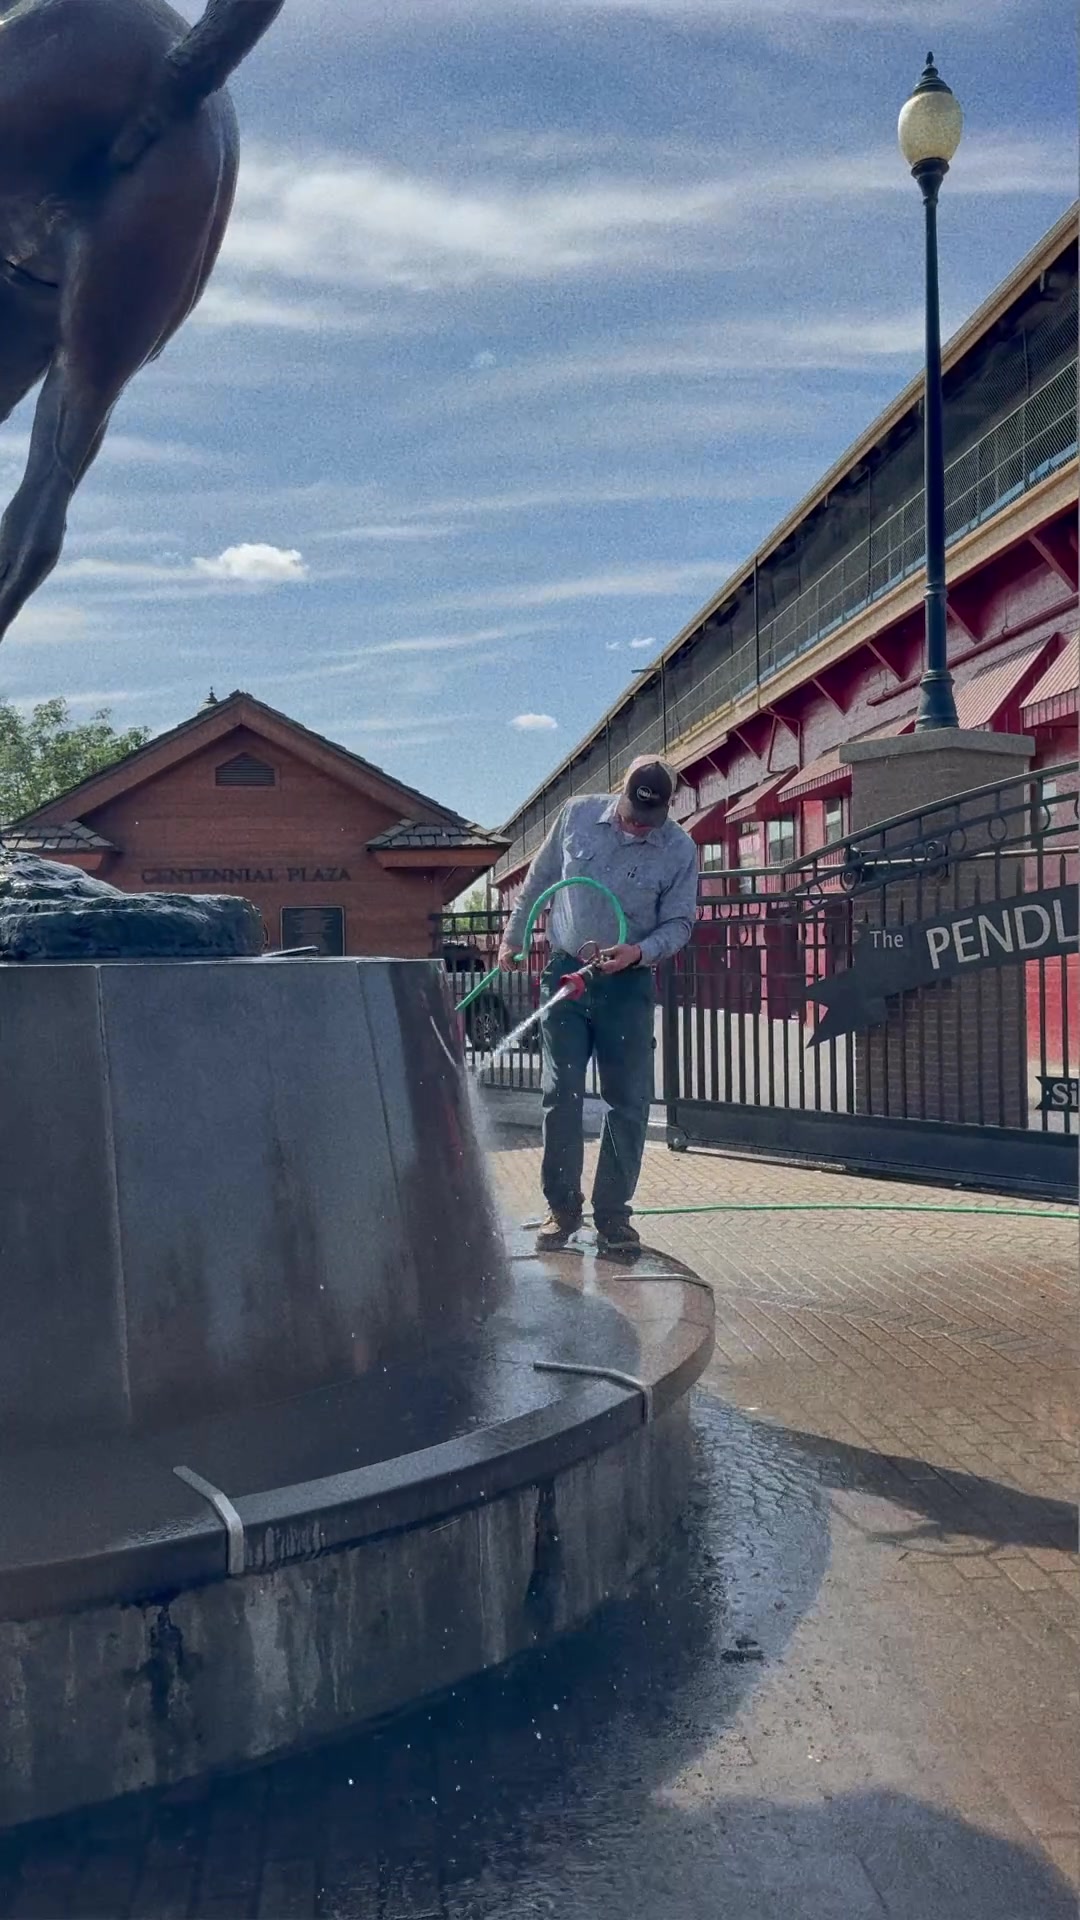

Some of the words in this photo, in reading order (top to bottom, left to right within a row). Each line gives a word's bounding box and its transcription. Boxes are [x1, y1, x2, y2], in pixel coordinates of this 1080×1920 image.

[142, 868, 279, 883] CENTENNIAL
[287, 867, 352, 882] PLAZA
[869, 930, 904, 948] The
[926, 899, 1078, 970] PENDL
